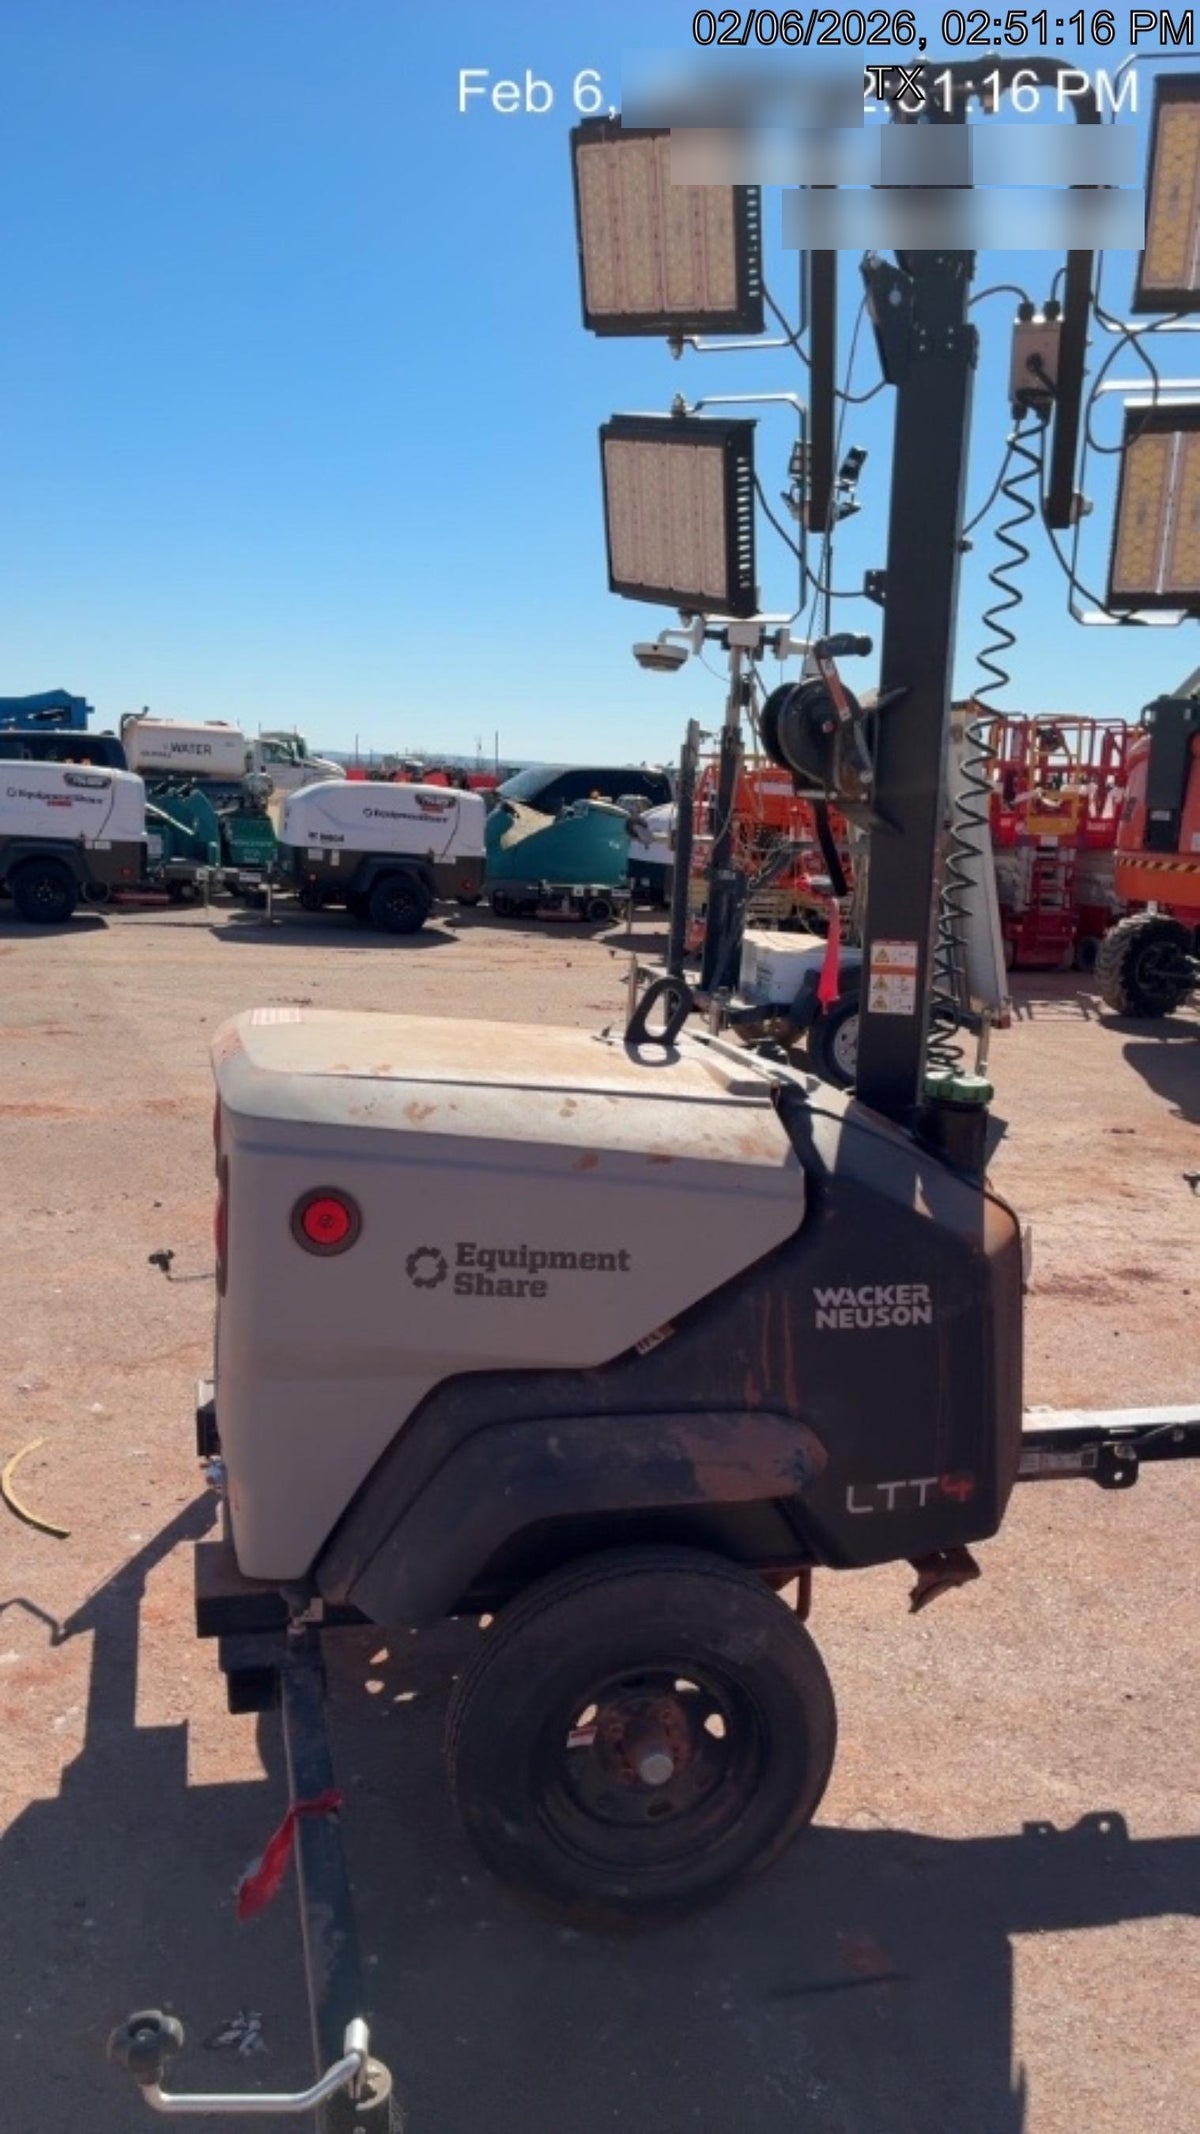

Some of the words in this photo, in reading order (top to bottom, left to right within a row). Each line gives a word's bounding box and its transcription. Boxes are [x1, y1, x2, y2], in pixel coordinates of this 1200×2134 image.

[171, 742, 212, 756] WATER
[455, 1242, 632, 1274] Equipment
[453, 1272, 548, 1298] Share
[813, 1283, 931, 1308] WACKER
[815, 1305, 933, 1329] NEUSON
